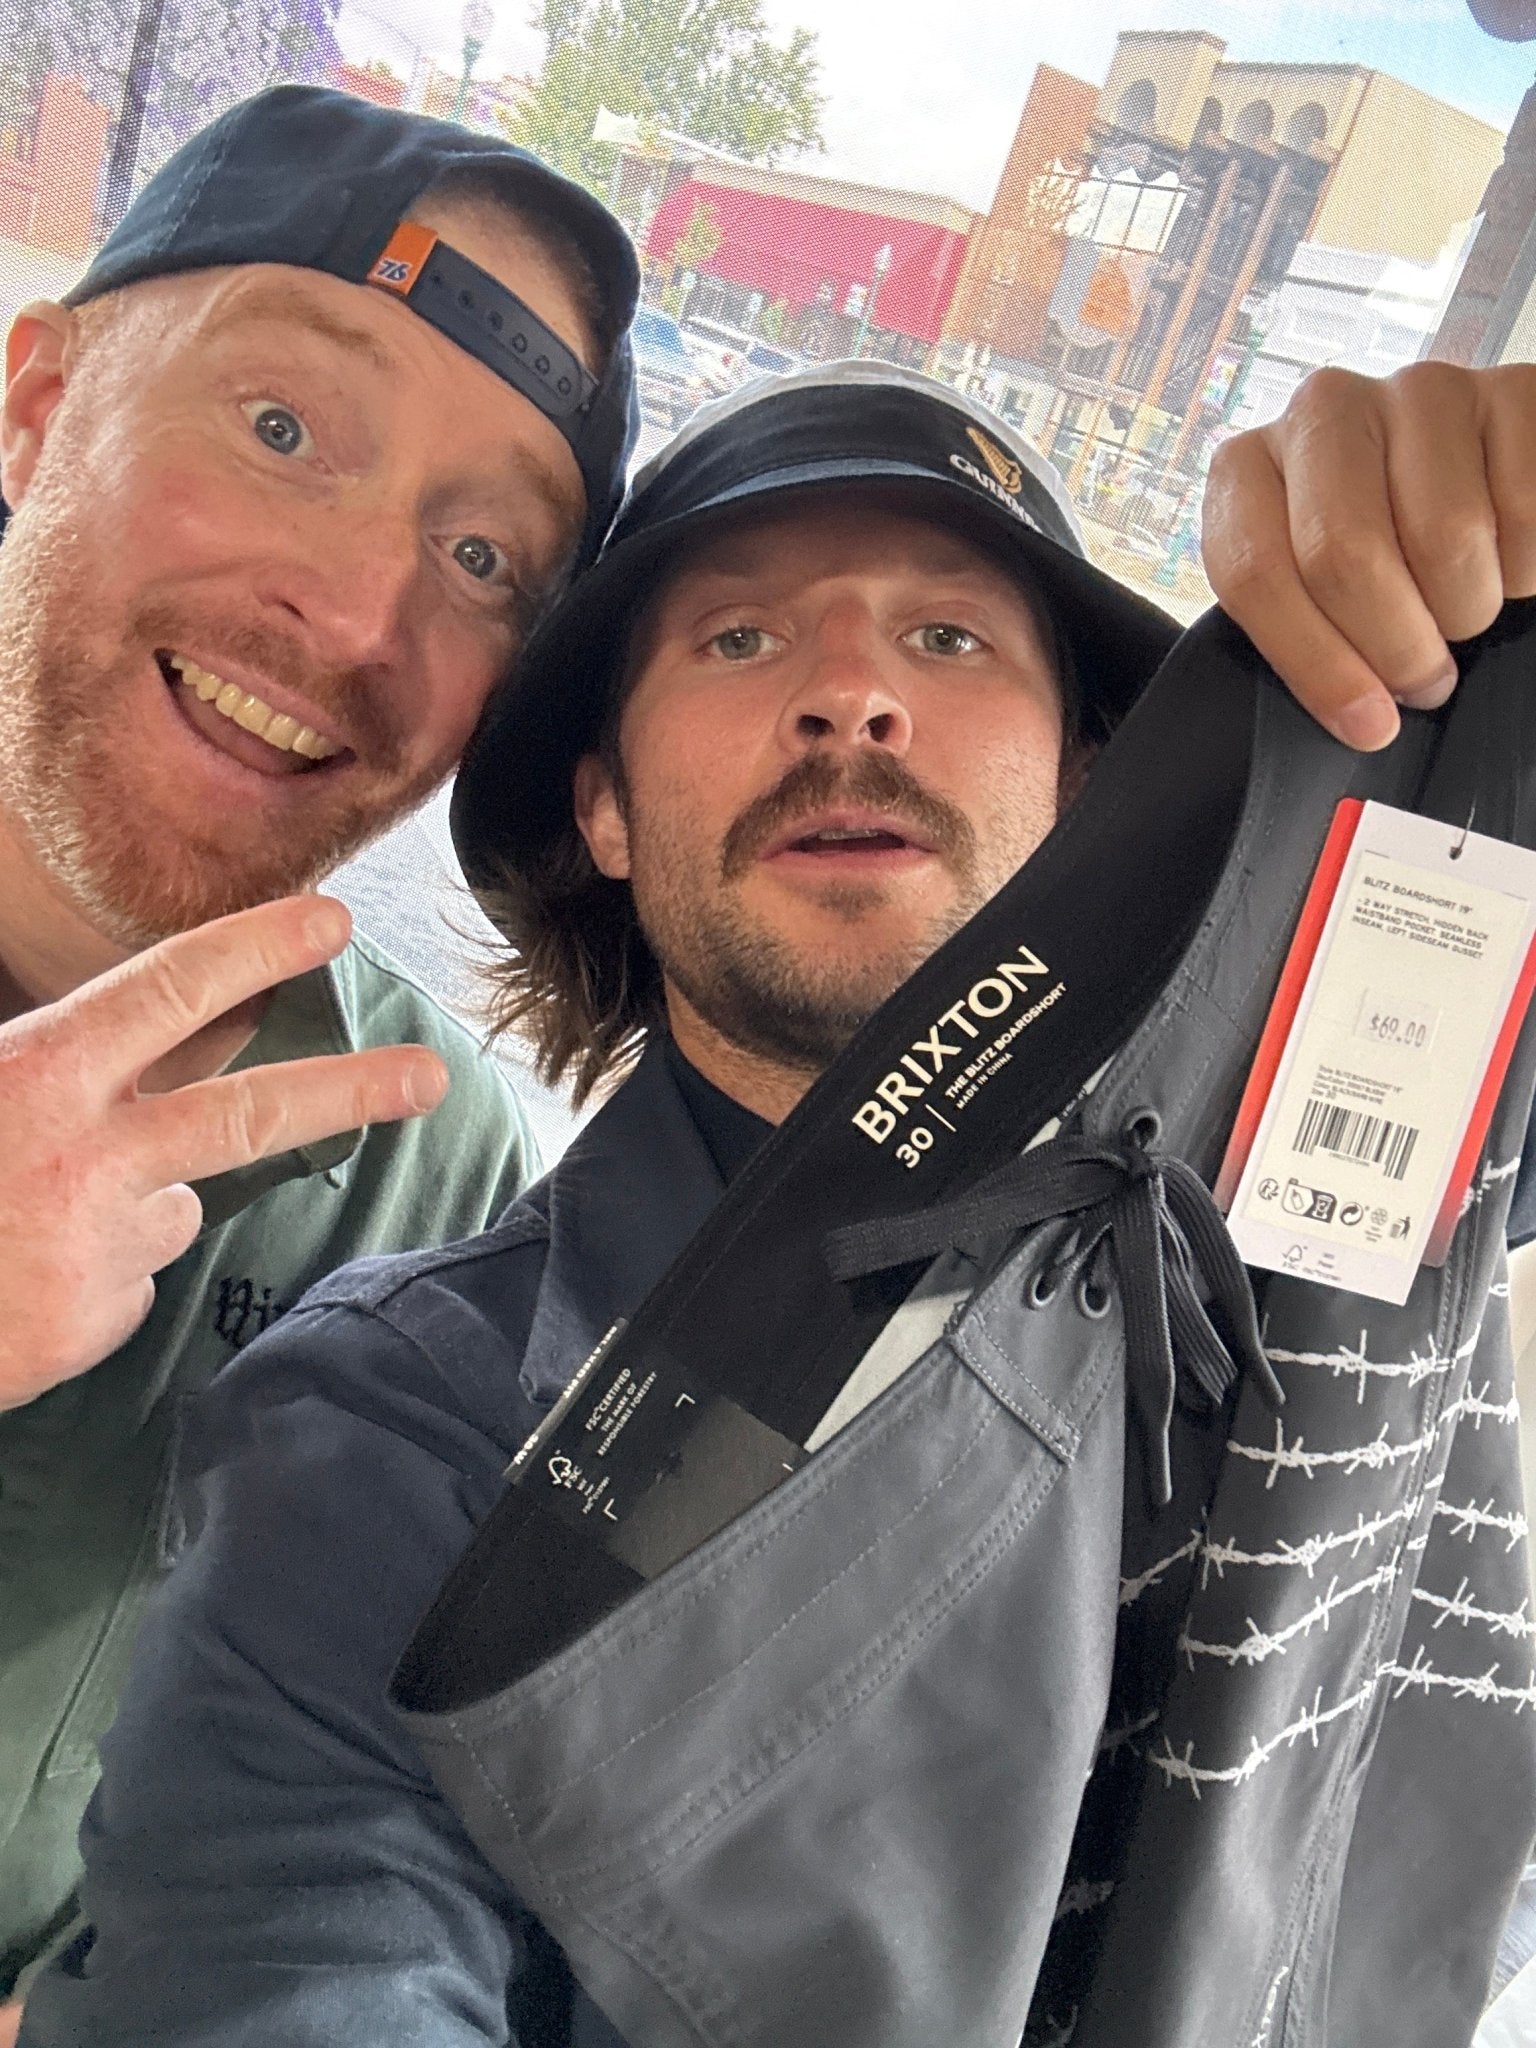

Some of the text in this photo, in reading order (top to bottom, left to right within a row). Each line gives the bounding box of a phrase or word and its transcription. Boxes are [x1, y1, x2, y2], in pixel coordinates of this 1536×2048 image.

[376, 259, 412, 283] 76
[1364, 876, 1391, 891] BLITZ
[1393, 885, 1457, 911] BOARDSHORT
[1355, 906, 1401, 926] WAISTBAND
[1440, 930, 1482, 949] SEAMLESS
[1364, 898, 1371, 906] 2
[1373, 900, 1392, 913] WAY
[1433, 918, 1464, 934] HIDDEN
[1467, 928, 1489, 941] BACK
[1387, 924, 1407, 937] LEFT
[1409, 932, 1450, 949] SIDESEAM
[1452, 945, 1484, 960] GUSSET
[852, 945, 1049, 1144] BRIXTON
[945, 982, 1067, 1098] THE BLITZ BOARDSHORT
[1368, 1013, 1426, 1048] $69.00
[956, 1053, 1013, 1110] MADE IN CHINA
[896, 1127, 934, 1168] 30
[599, 1368, 631, 1412] CERTIFIED
[600, 1382, 637, 1432] THE MARK OF
[597, 1371, 657, 1456] RESPONSIBLE FORESTRY
[564, 1465, 582, 1489] FSC
